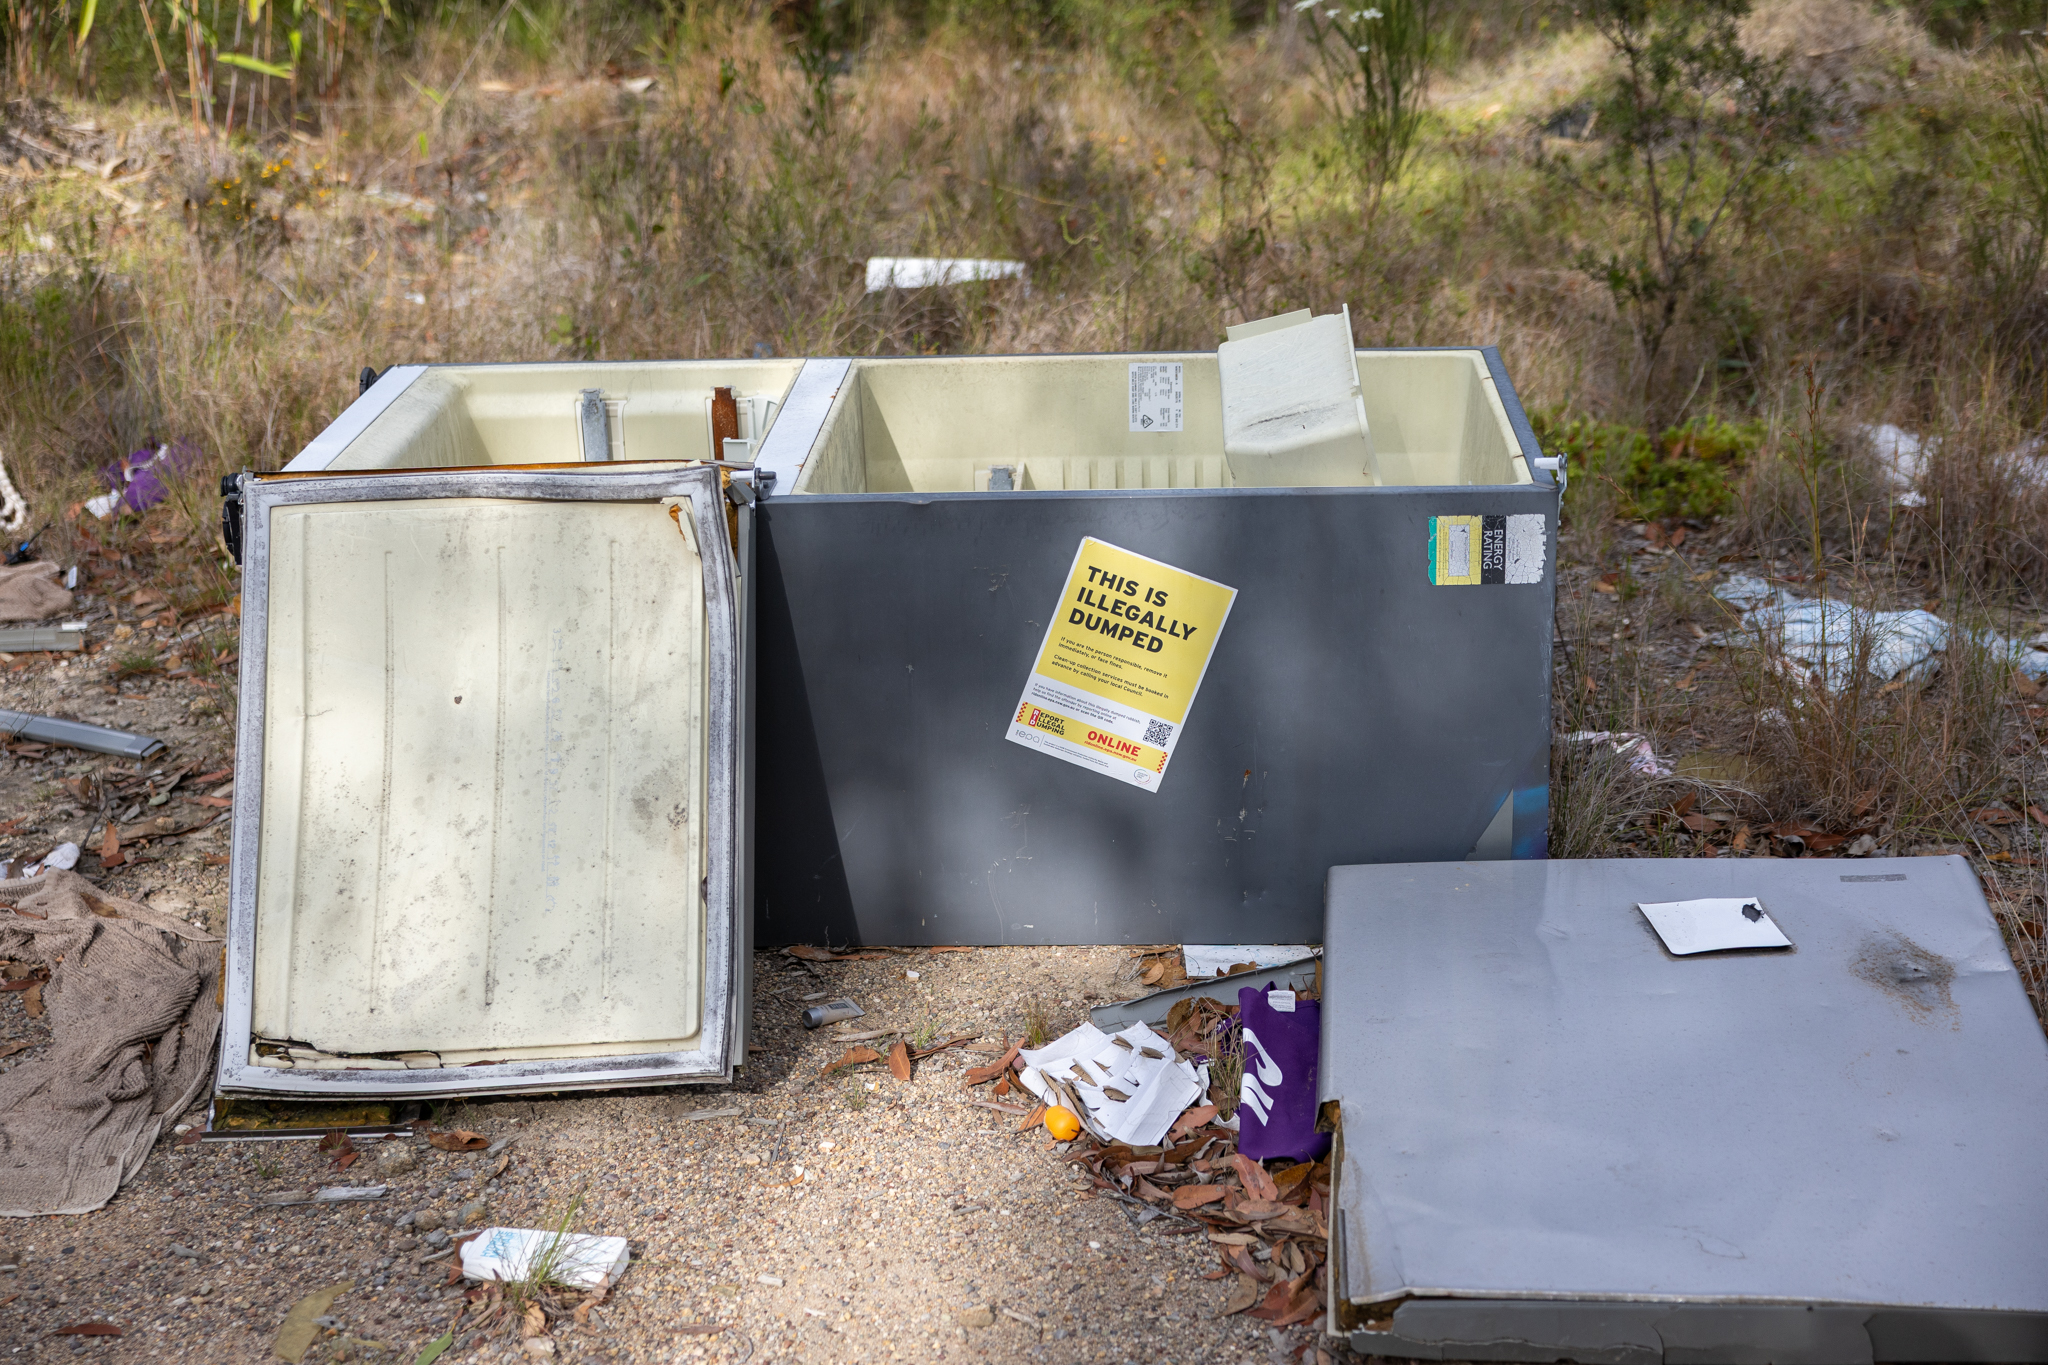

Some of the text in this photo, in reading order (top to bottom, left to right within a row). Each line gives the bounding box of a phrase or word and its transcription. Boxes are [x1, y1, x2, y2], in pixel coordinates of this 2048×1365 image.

[1483, 530, 1493, 570] RATING
[1493, 529, 1503, 571] ENERGY
[1088, 565, 1169, 608] THIS IS
[1068, 607, 1164, 653] DUMPED
[1077, 587, 1197, 641] ILLEGALLY
[1051, 660, 1073, 671] advance
[1072, 667, 1080, 675] by
[1079, 671, 1098, 681] calling
[1097, 677, 1110, 685] your
[1109, 681, 1123, 689] local
[1053, 654, 1077, 666] Clean-up
[1076, 663, 1102, 675] collection
[1102, 672, 1123, 683] services
[1123, 680, 1138, 688] must
[1144, 687, 1164, 697] booked
[1065, 638, 1076, 646] you
[1085, 645, 1095, 653] the
[1094, 649, 1113, 659] person
[1112, 655, 1143, 669] responsible,
[1143, 666, 1163, 677] remove
[1097, 656, 1109, 664] face
[1019, 730, 1040, 744] epa
[1087, 730, 1142, 757] ONLINE
